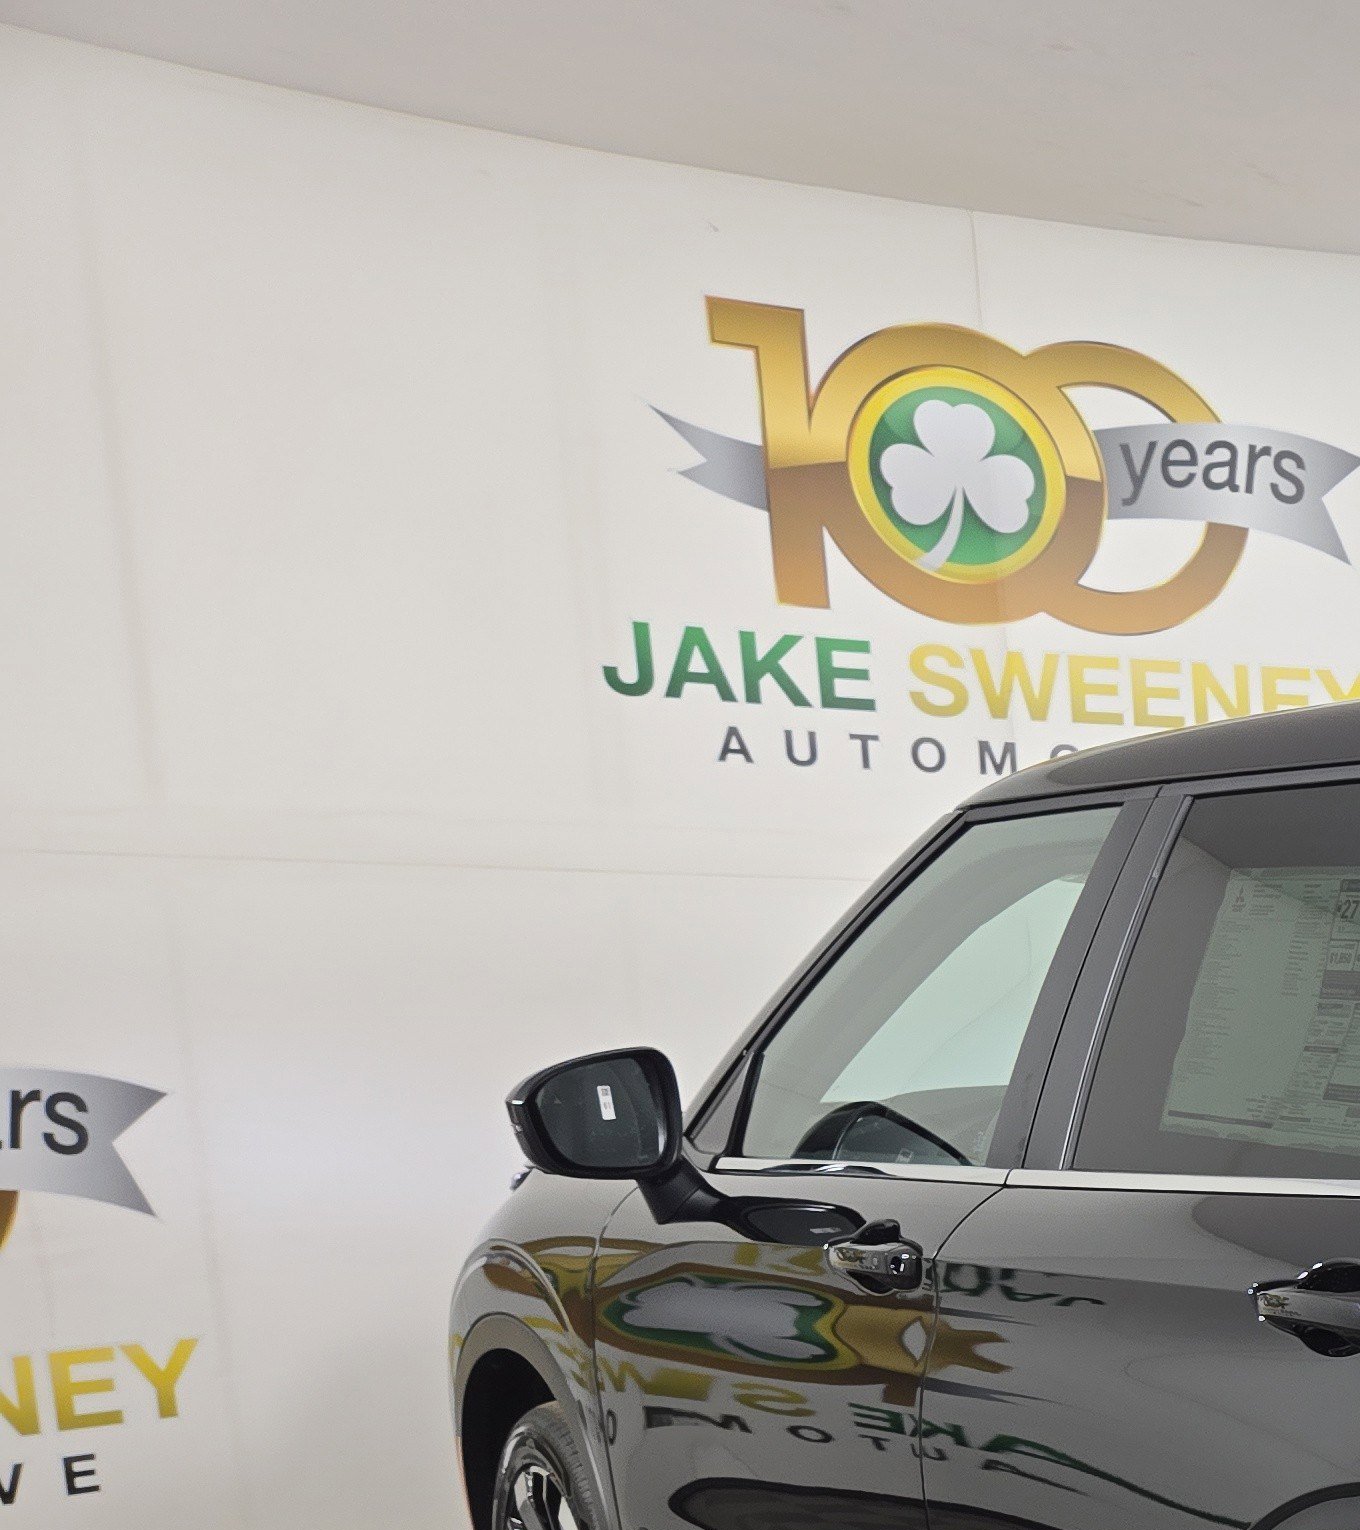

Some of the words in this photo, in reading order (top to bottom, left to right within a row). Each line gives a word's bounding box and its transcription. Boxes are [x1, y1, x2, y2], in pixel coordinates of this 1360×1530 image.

[704, 295, 1249, 635] 100
[1119, 434, 1308, 505] years
[602, 621, 876, 711] JAKE
[717, 725, 1079, 775] AUTOM
